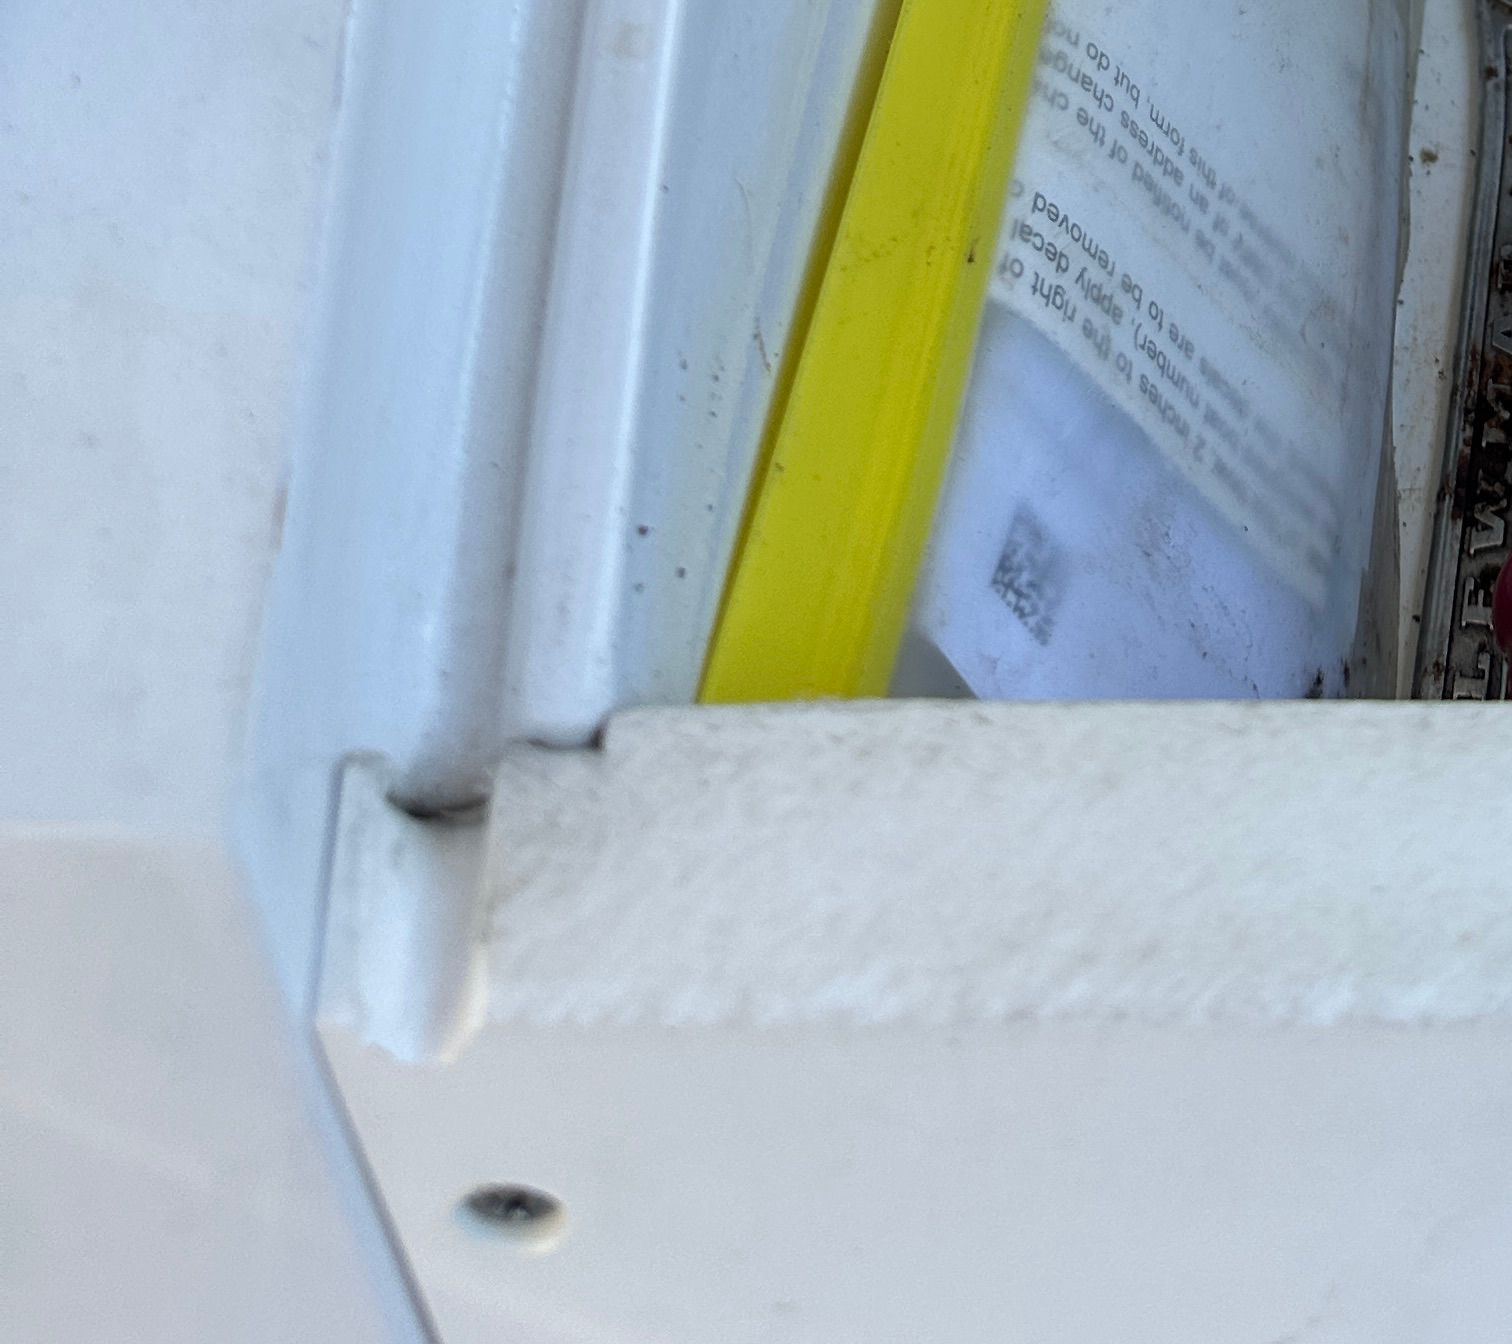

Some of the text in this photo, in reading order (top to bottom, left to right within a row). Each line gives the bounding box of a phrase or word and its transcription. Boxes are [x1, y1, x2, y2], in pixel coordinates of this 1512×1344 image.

[1086, 42, 1111, 71] do
[1113, 65, 1141, 109] but
[1076, 107, 1106, 148] the
[1120, 110, 1184, 186] address
[1109, 139, 1129, 164] of
[1011, 218, 1070, 274] decal
[1031, 192, 1195, 360] are to be removed
[1031, 271, 1077, 324] right
[1075, 266, 1124, 325] apply
[1082, 318, 1112, 361] the
[1115, 352, 1133, 383] to
